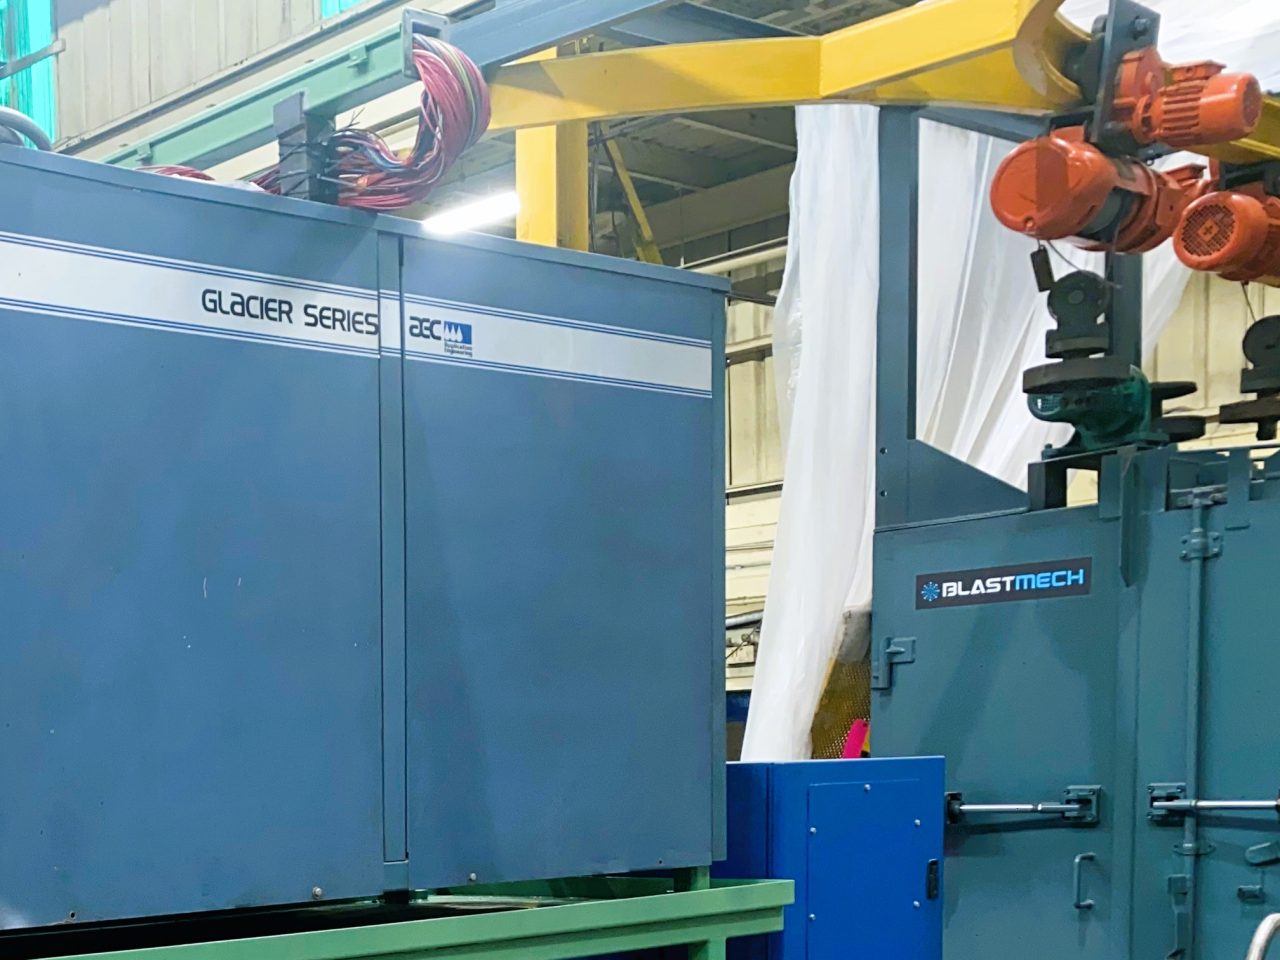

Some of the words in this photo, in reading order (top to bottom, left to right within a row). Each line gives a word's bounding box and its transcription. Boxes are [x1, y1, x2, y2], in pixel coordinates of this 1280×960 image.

[201, 288, 293, 324] GLACIER
[303, 303, 380, 336] SERIES
[942, 568, 1085, 598] BLASTMECH
